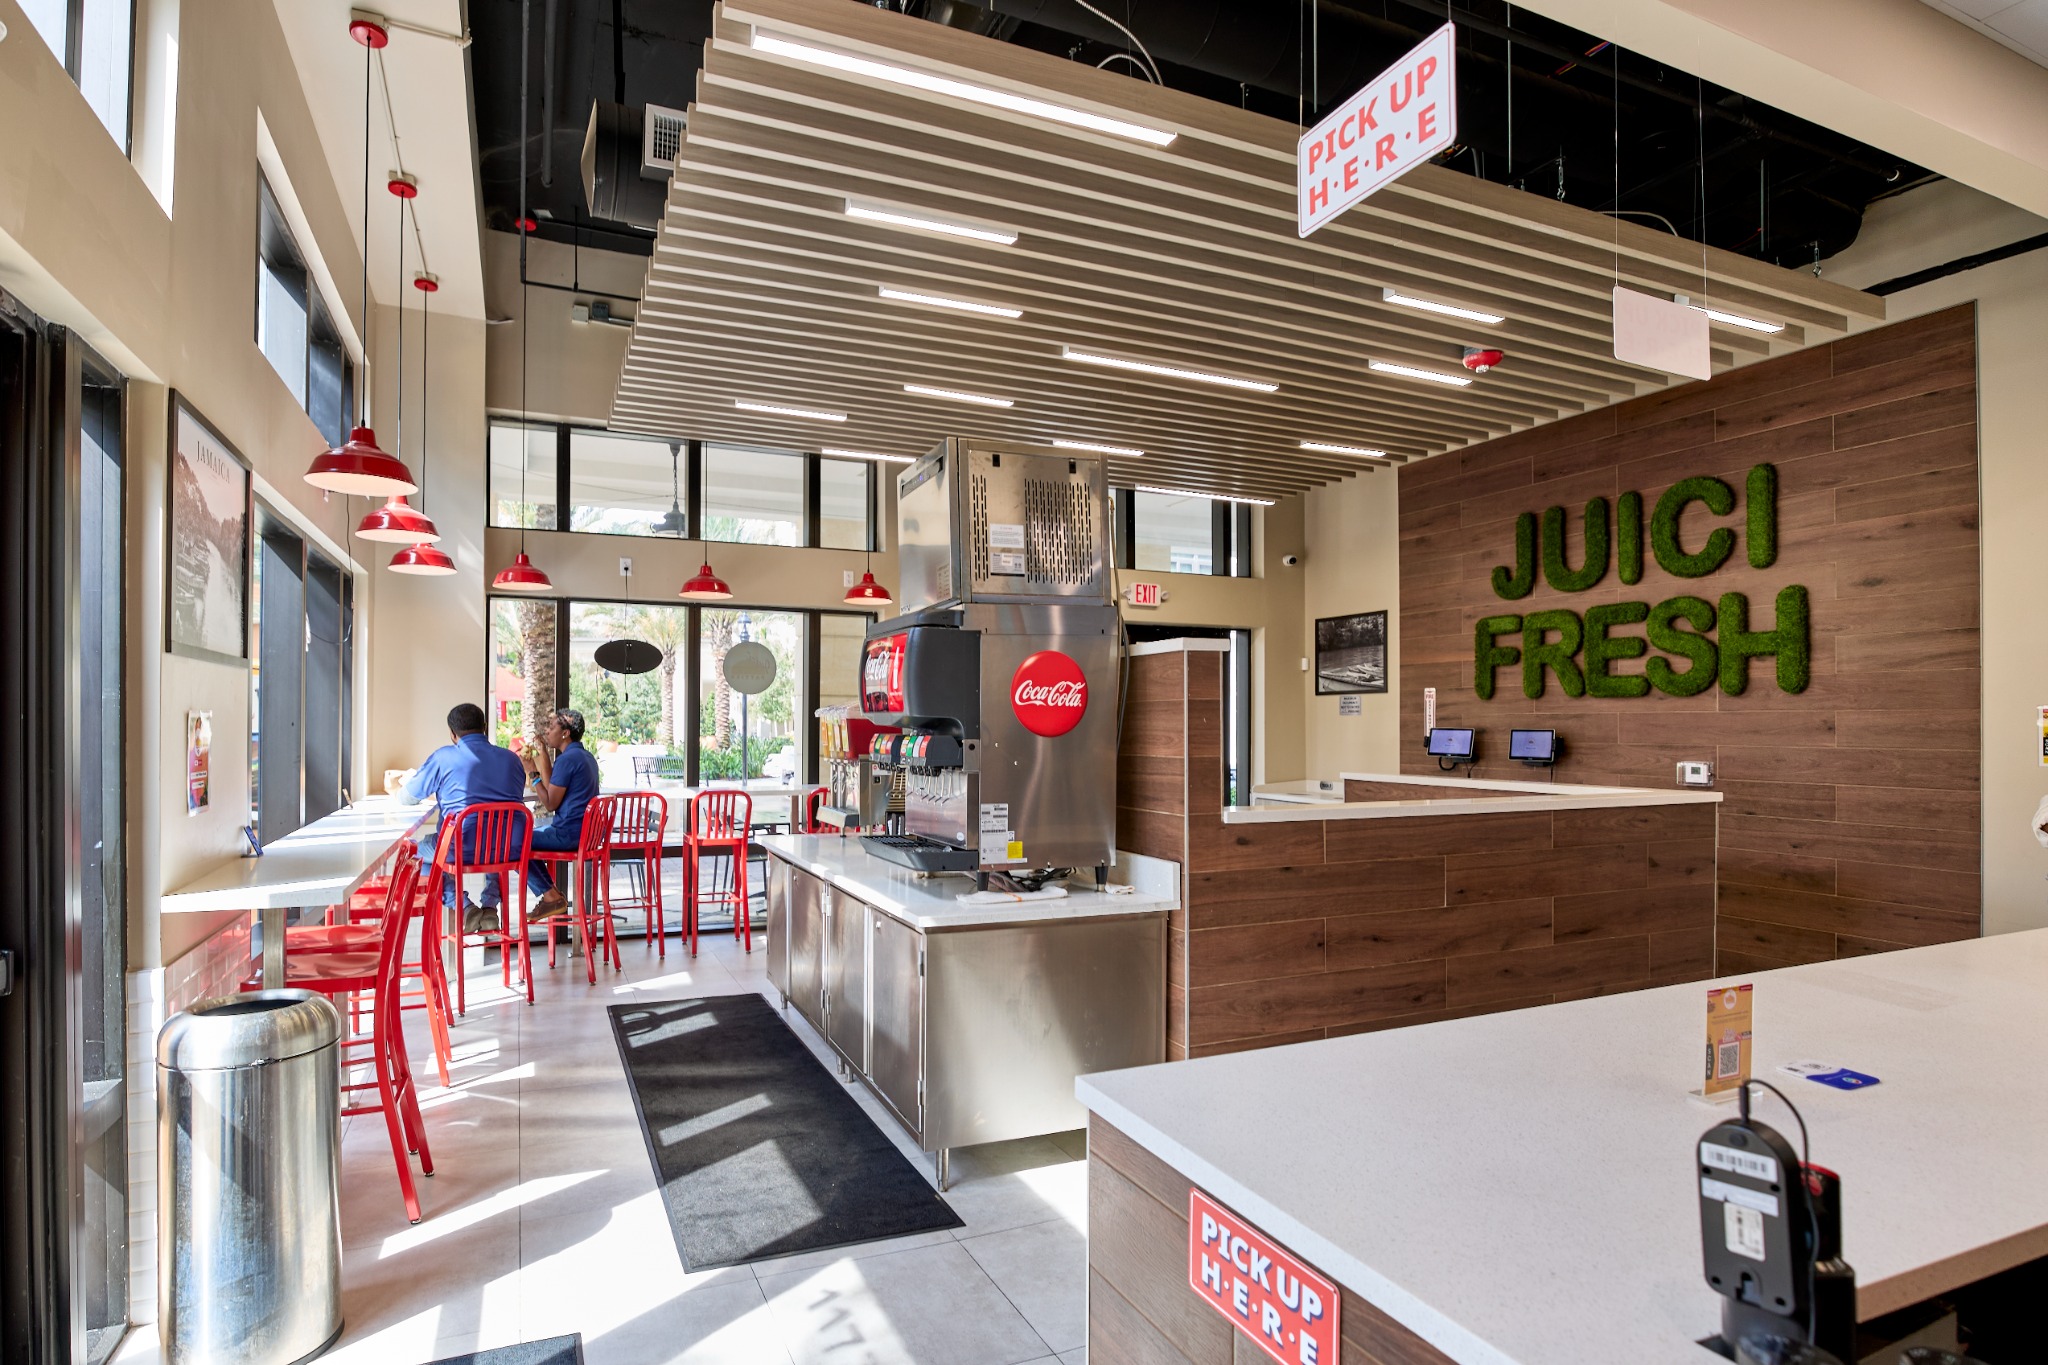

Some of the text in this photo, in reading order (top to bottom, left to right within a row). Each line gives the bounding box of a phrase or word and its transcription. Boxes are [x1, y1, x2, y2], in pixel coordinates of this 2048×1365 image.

[1309, 55, 1437, 176] PICK UP
[197, 441, 230, 484] JAMAICA
[1491, 463, 1778, 600] JUICI
[1136, 584, 1157, 604] EXIT
[1474, 585, 1811, 700] FRESH
[1015, 680, 1085, 707] Coca-Cola
[1202, 1211, 1323, 1325] PICK UP
